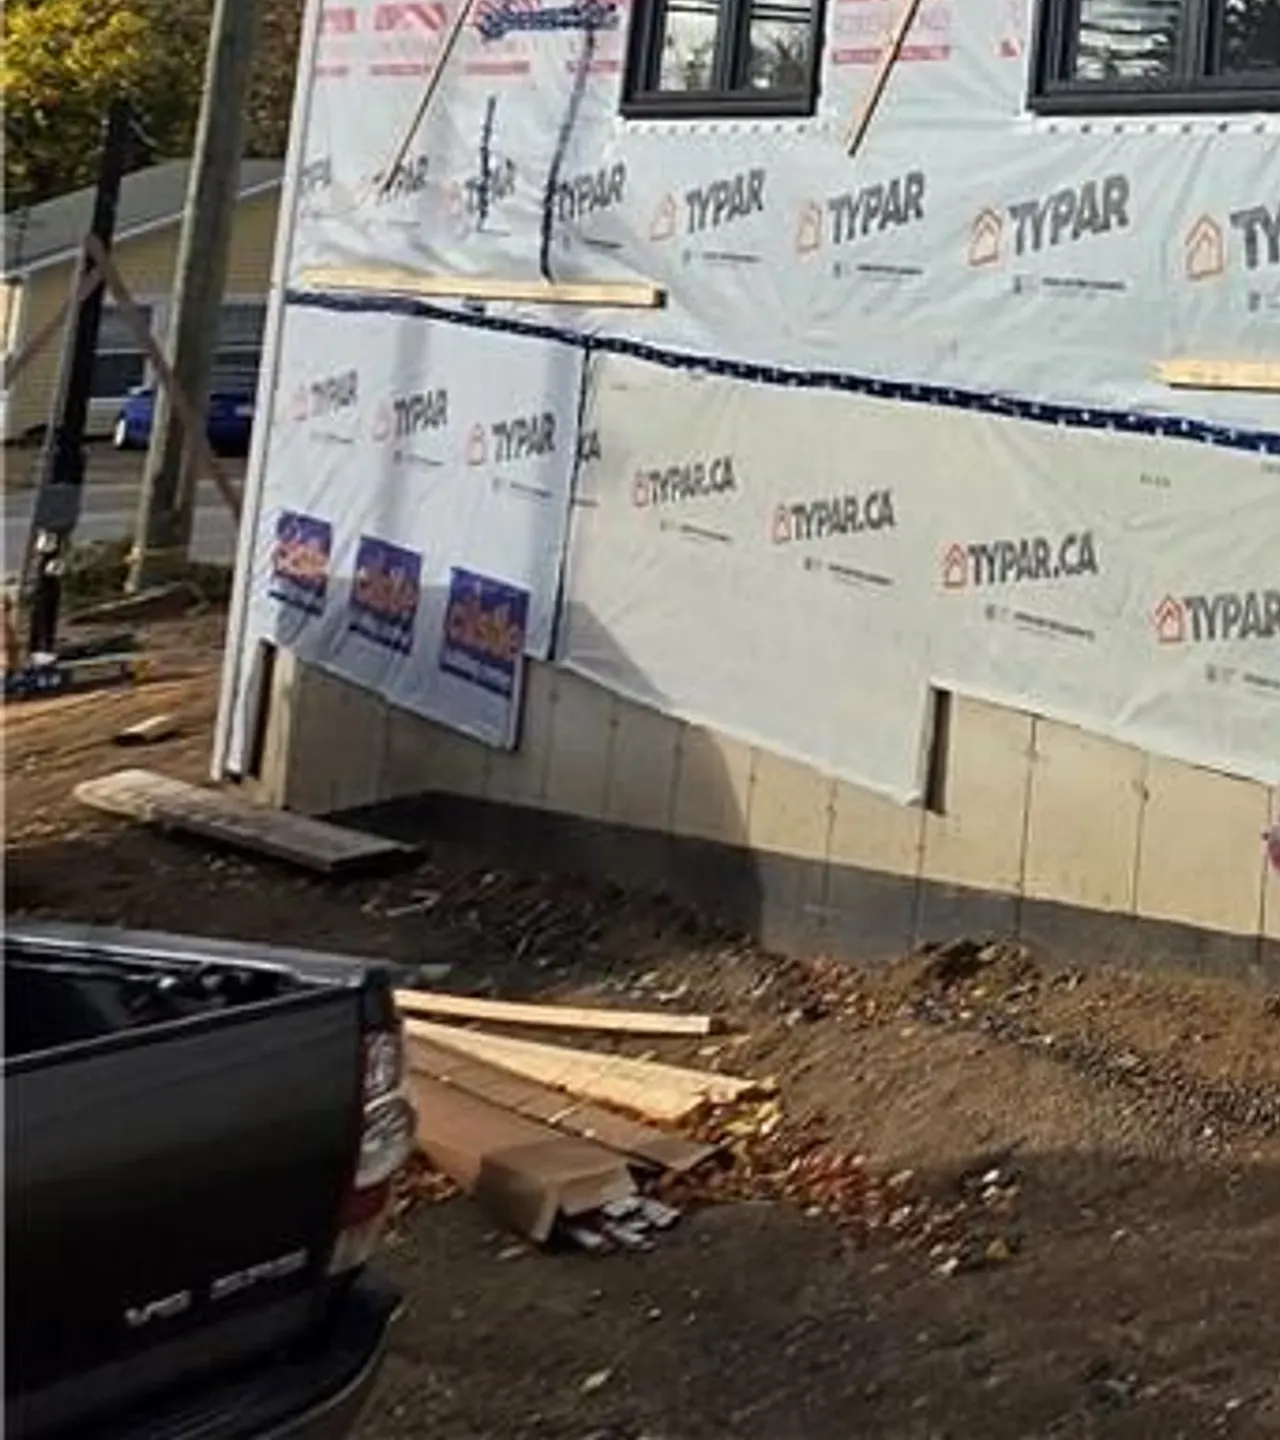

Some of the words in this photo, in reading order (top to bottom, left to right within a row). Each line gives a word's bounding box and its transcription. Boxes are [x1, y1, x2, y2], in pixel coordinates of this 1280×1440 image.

[685, 168, 765, 234] TYPAR
[828, 171, 925, 244] TYPAR
[1008, 173, 1131, 256] TYPAR
[393, 389, 449, 437] TYPAR
[491, 411, 557, 463] TYPAR
[649, 456, 738, 505] TYPAR.CA
[790, 488, 896, 542] TYPAR.CA
[966, 530, 1099, 587] TYPAR.CA
